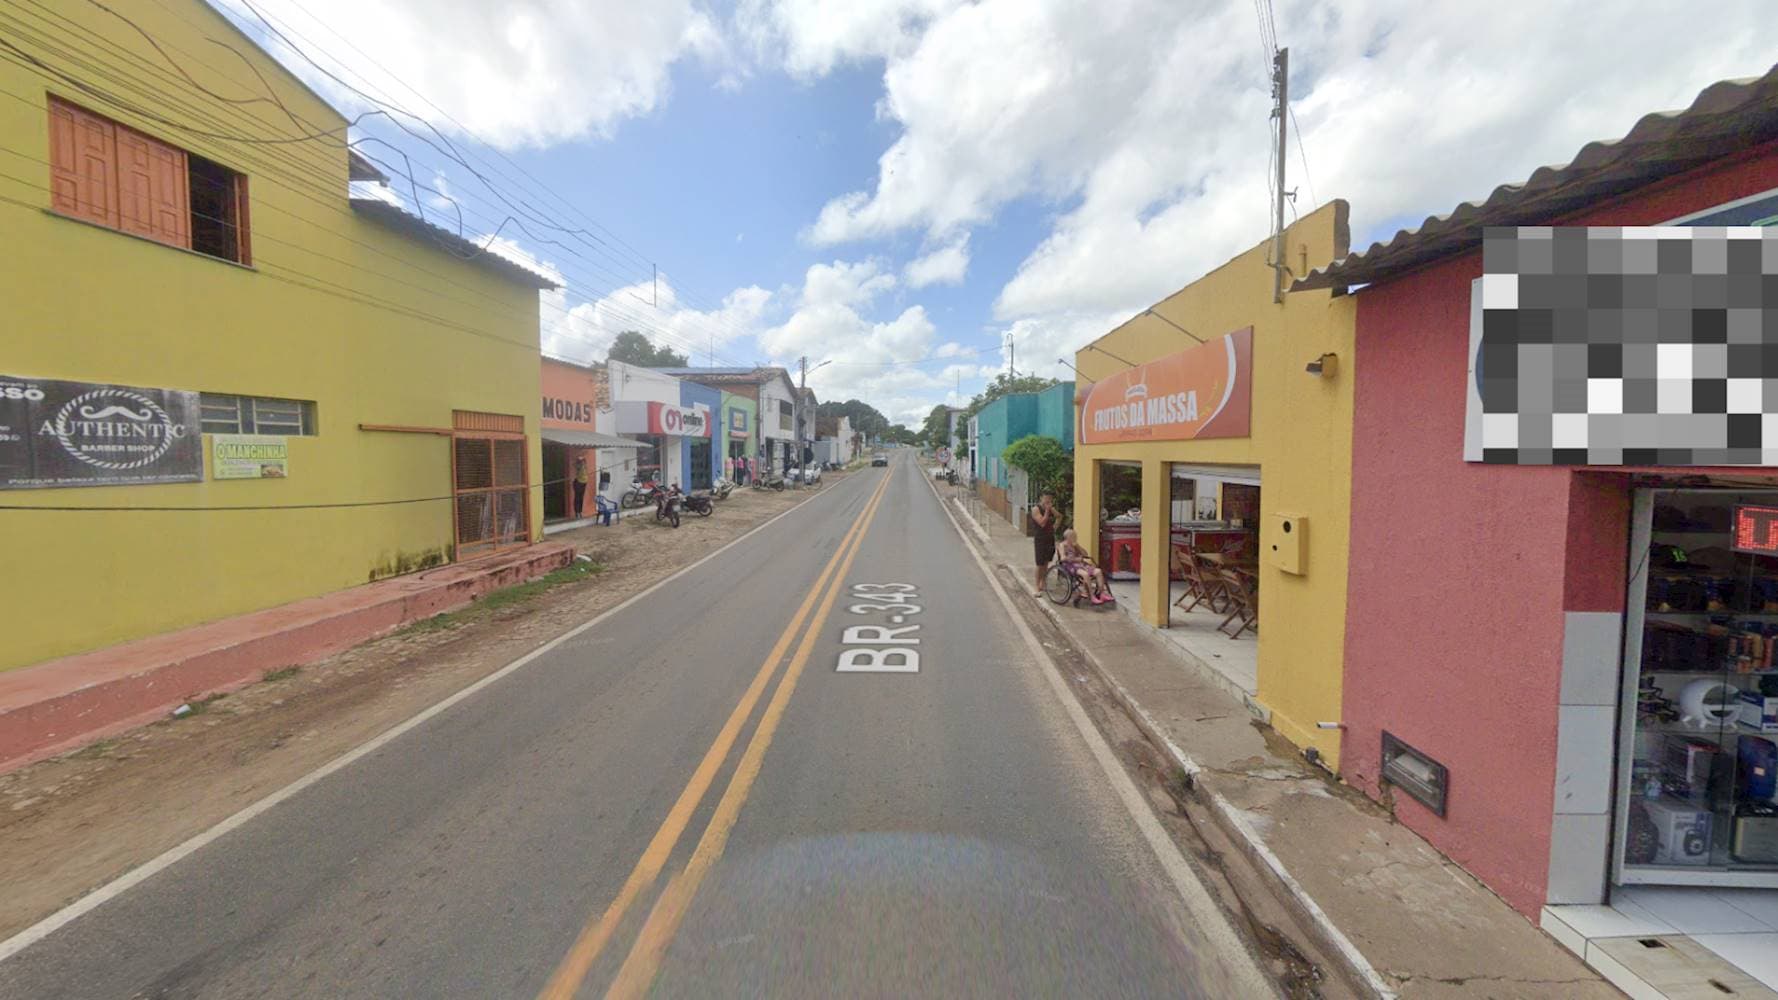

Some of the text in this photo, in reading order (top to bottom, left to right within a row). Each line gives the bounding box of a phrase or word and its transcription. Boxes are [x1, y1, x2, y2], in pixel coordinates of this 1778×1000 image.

[0, 387, 45, 400] SO
[542, 396, 591, 423] MODAS
[1095, 391, 1198, 432] FRUTOS DA MASSA
[38, 420, 186, 439] AUTHENTIC
[81, 444, 155, 452] BARBER SHOP
[216, 443, 288, 459] O MANCHINHA
